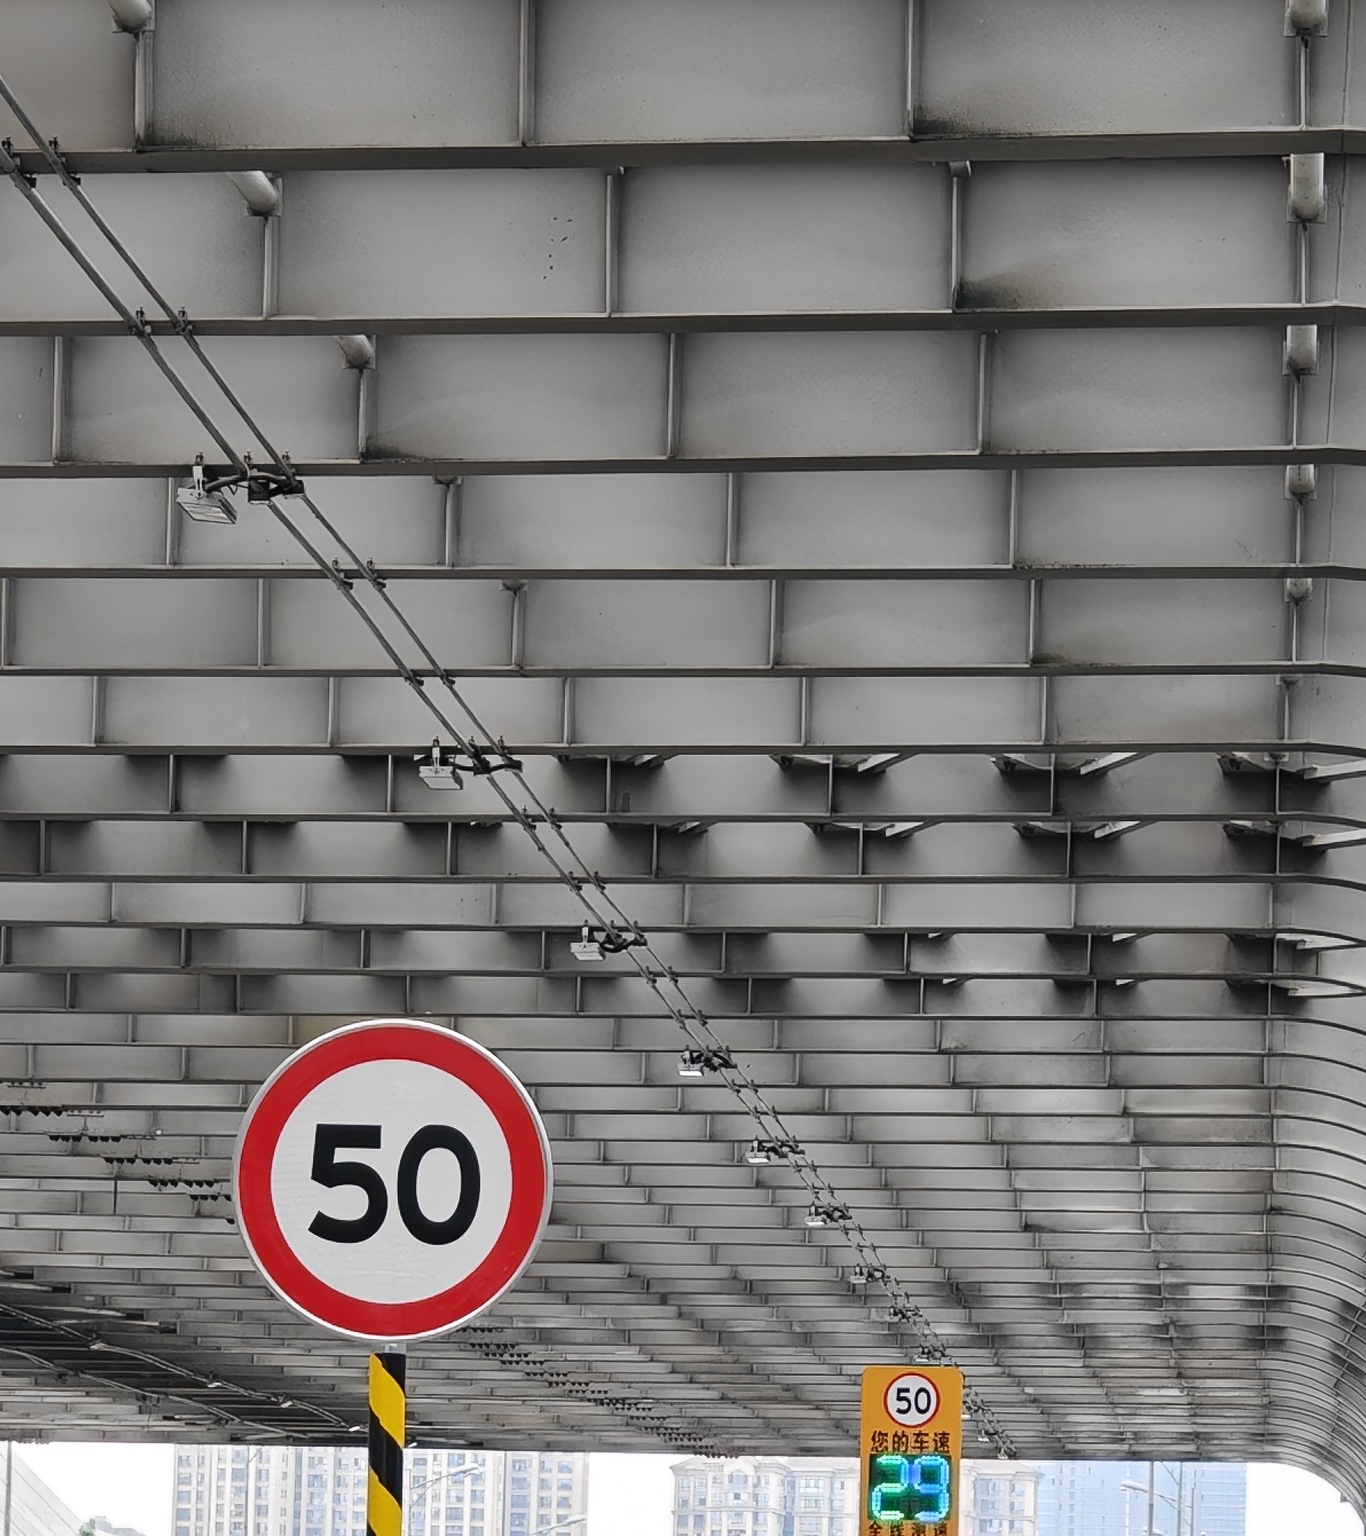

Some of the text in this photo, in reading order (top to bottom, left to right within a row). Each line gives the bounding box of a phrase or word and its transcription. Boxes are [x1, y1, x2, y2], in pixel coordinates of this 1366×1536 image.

[308, 1123, 481, 1246] 50
[895, 1387, 932, 1415] 50
[871, 1430, 951, 1454] 您的车速
[871, 1455, 950, 1522] 29
